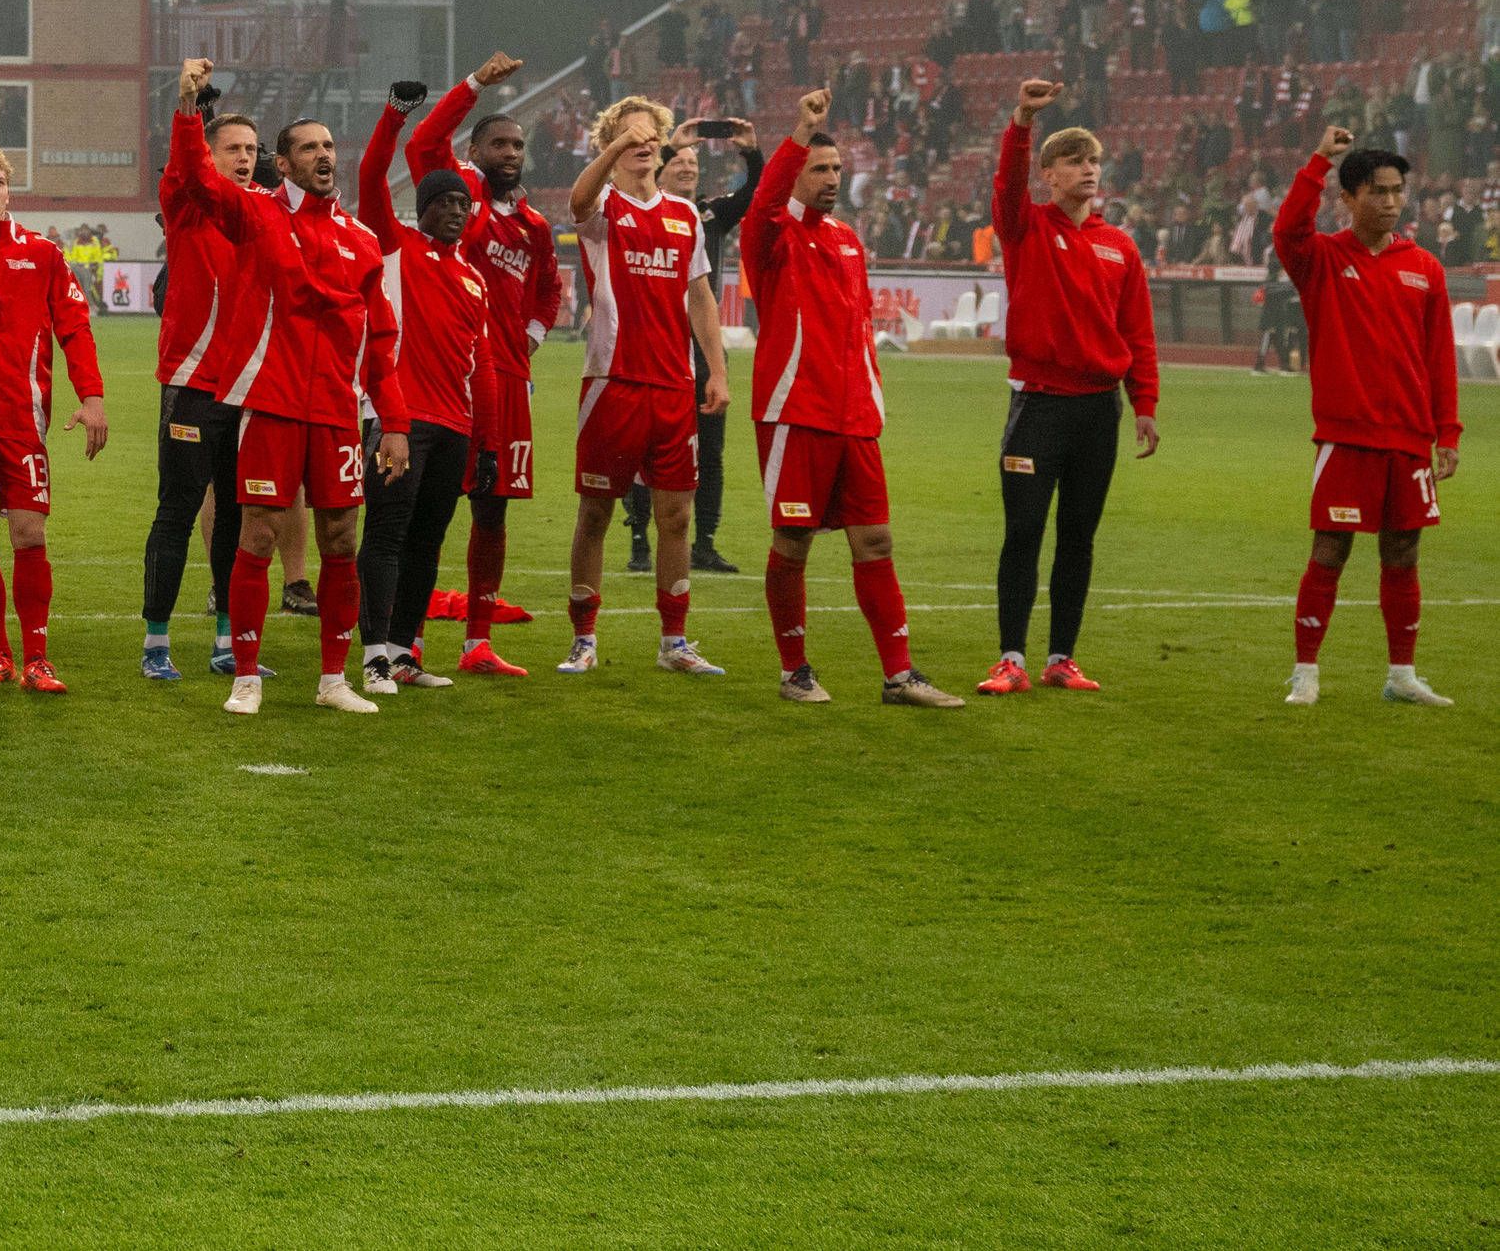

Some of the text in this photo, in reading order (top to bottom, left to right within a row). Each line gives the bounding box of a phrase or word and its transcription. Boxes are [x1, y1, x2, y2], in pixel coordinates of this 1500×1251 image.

[22, 453, 48, 488] 13
[339, 443, 363, 483] 28
[509, 440, 533, 474] 17
